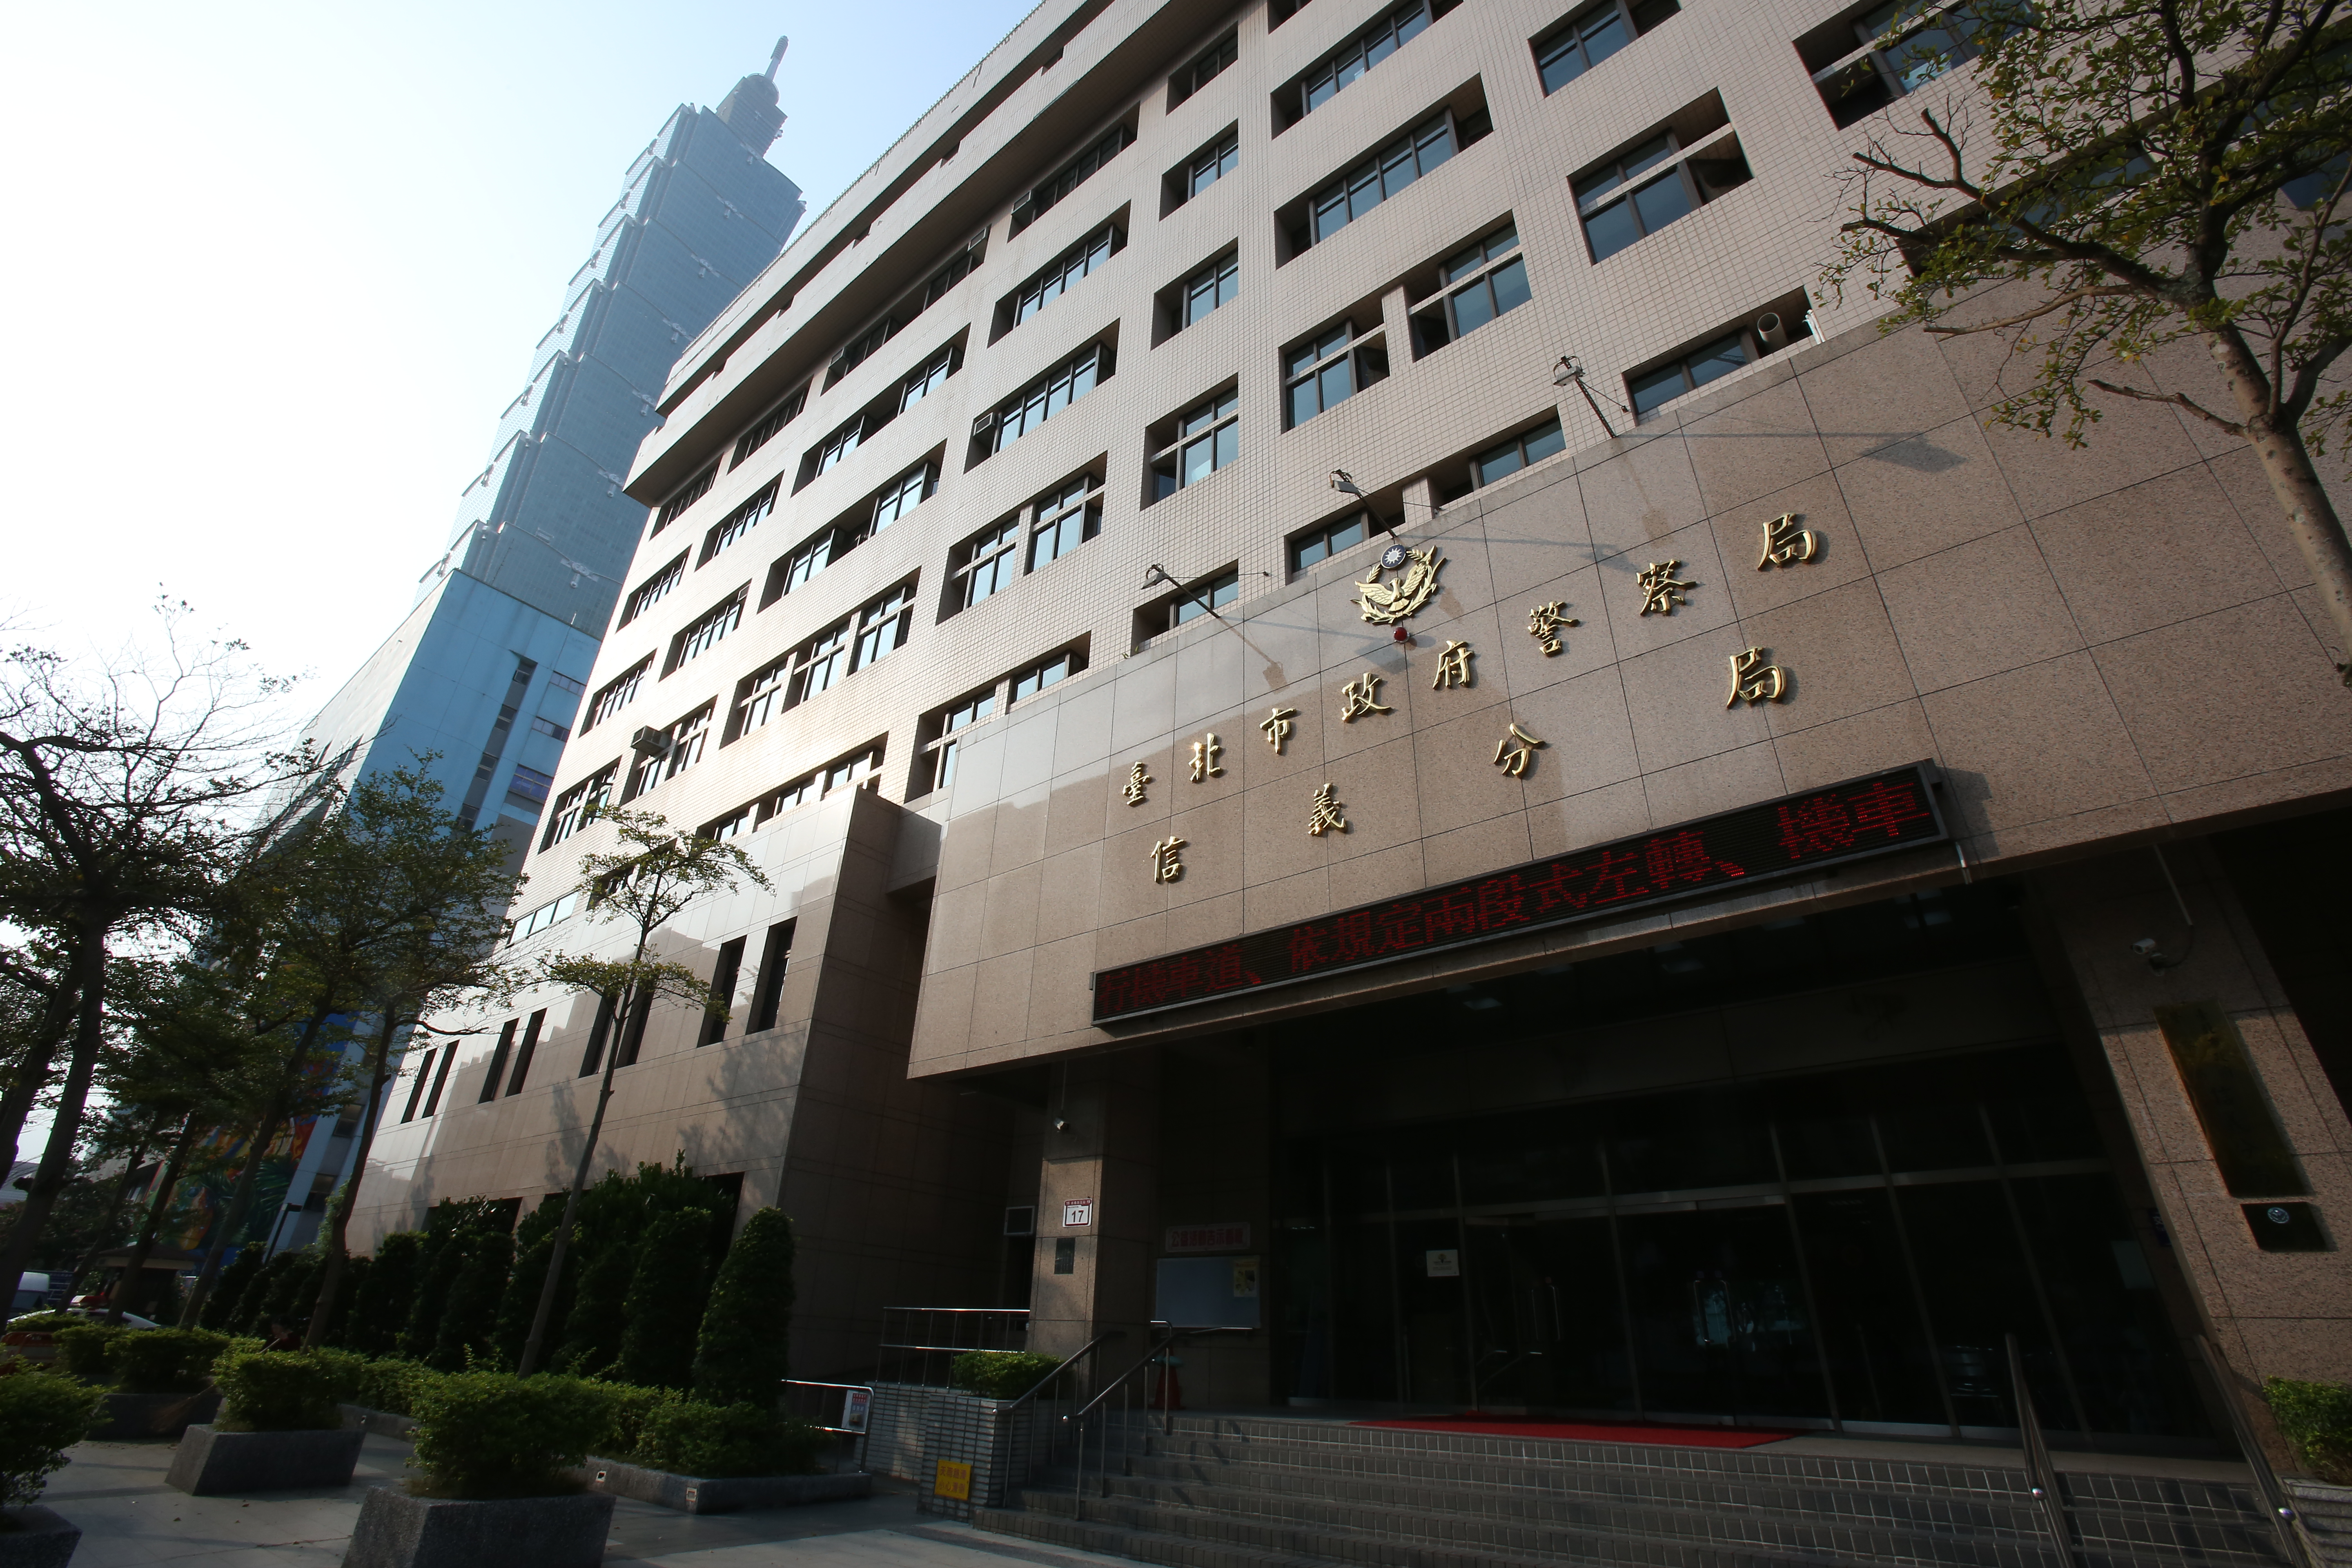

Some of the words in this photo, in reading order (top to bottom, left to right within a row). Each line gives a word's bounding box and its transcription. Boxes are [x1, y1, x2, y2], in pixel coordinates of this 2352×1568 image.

[1122, 513, 1817, 806] 臺北市政府警察局
[1150, 646, 1787, 882] 信義分局
[1778, 782, 1929, 859] 機車
[1072, 1210, 1084, 1223] 17
